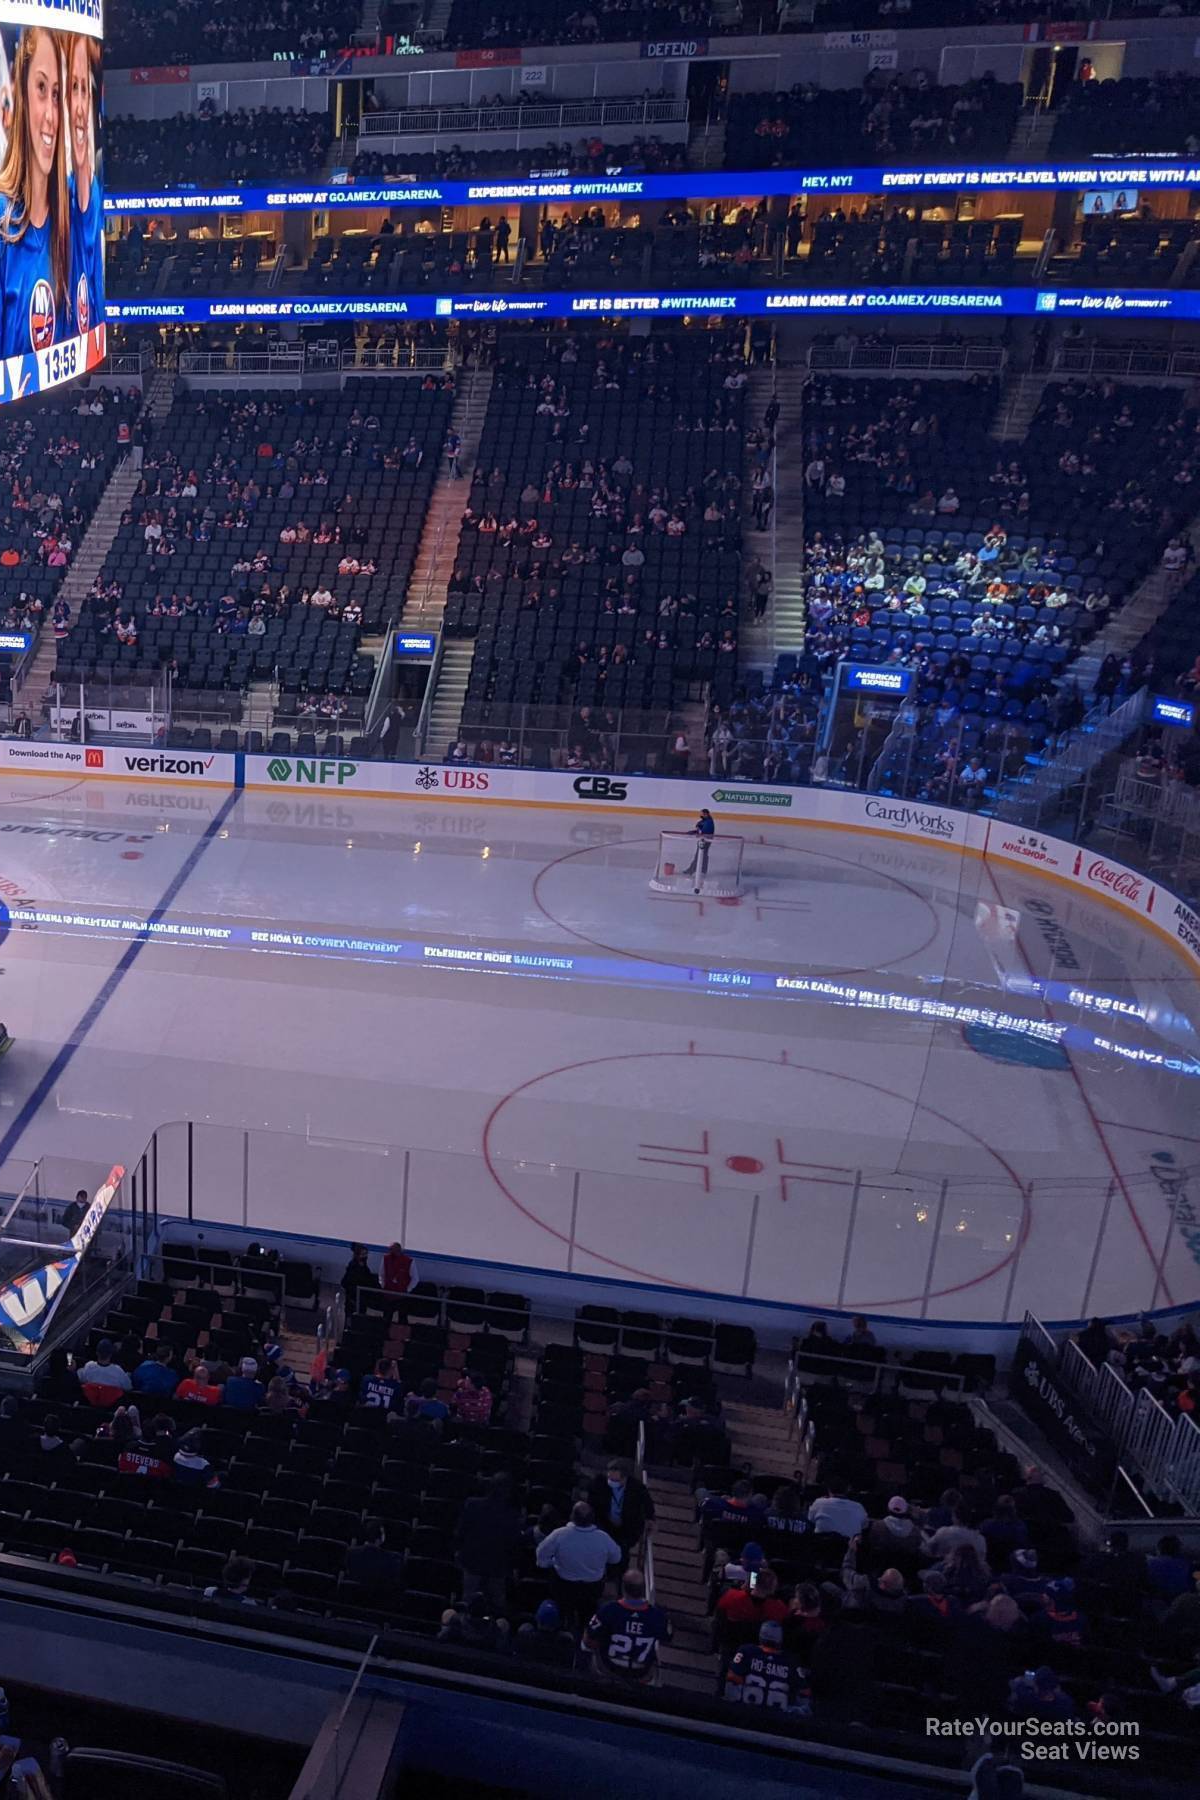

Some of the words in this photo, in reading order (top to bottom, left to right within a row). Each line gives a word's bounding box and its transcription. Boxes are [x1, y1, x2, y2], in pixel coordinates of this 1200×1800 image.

[647, 42, 697, 57] DEFEND
[873, 54, 893, 66] 223
[524, 71, 543, 81] 222
[200, 87, 216, 96] 221
[802, 176, 828, 188] HEY,
[829, 175, 852, 186] NY!
[882, 174, 922, 186] EVERY
[924, 173, 964, 185] EVENT
[966, 172, 979, 184] IS
[981, 171, 1056, 184] NEXT-LEVEL
[1057, 170, 1097, 183] WHEN
[1099, 170, 1146, 183] YOU'RE
[1149, 170, 1184, 182] WITH
[267, 193, 287, 204] SEE
[288, 192, 313, 203] HOW
[314, 192, 327, 202] AT
[329, 189, 442, 202] GO.AMEX/UBSARENA.
[468, 185, 537, 198] EXPERIENCE
[538, 184, 571, 195] MORE
[573, 182, 642, 195] #WITHAMEX
[116, 198, 145, 208] WHEN
[147, 197, 182, 207] YOU'RE
[183, 196, 210, 207] WITH
[211, 195, 242, 206] AMEX.
[474, 300, 491, 312] live
[492, 300, 507, 312] life
[508, 302, 535, 310] WITHOUT
[573, 299, 598, 310] LIFE
[599, 298, 611, 310] IS
[613, 298, 659, 309] BETTER
[661, 296, 736, 308] #WITHAMEX
[767, 296, 808, 308] LEARN
[810, 296, 849, 307] MORE
[850, 295, 866, 306] AT
[867, 294, 1002, 307] GO.AMEX/UBSARENA
[1082, 295, 1103, 309] live
[1104, 295, 1123, 309] life
[1125, 299, 1158, 308] WITHOUT
[122, 305, 184, 316] #WITHAMEX
[210, 303, 245, 315] LEARN
[246, 303, 277, 314] MORE
[278, 303, 292, 314] AT
[293, 302, 407, 314] GO.AMEX/UBSARENA
[44, 342, 76, 384] 13:58
[856, 672, 901, 681] AMERICAN
[861, 680, 901, 688] EXPRESS
[9, 747, 47, 760] Download
[48, 750, 63, 761] the
[65, 751, 82, 763] App
[124, 754, 204, 775] verizon
[296, 760, 357, 784] NFP
[443, 770, 489, 790] UBS
[725, 792, 759, 802] NATURE'S
[759, 794, 790, 805] BOUNTY
[865, 801, 955, 832] CardWorks
[1002, 841, 1059, 866] NHLSHOP.com
[1088, 860, 1144, 902] Coca-Cola
[1039, 1376, 1065, 1419] UBS
[625, 1621, 644, 1634] LEE
[608, 1633, 656, 1667] 27
